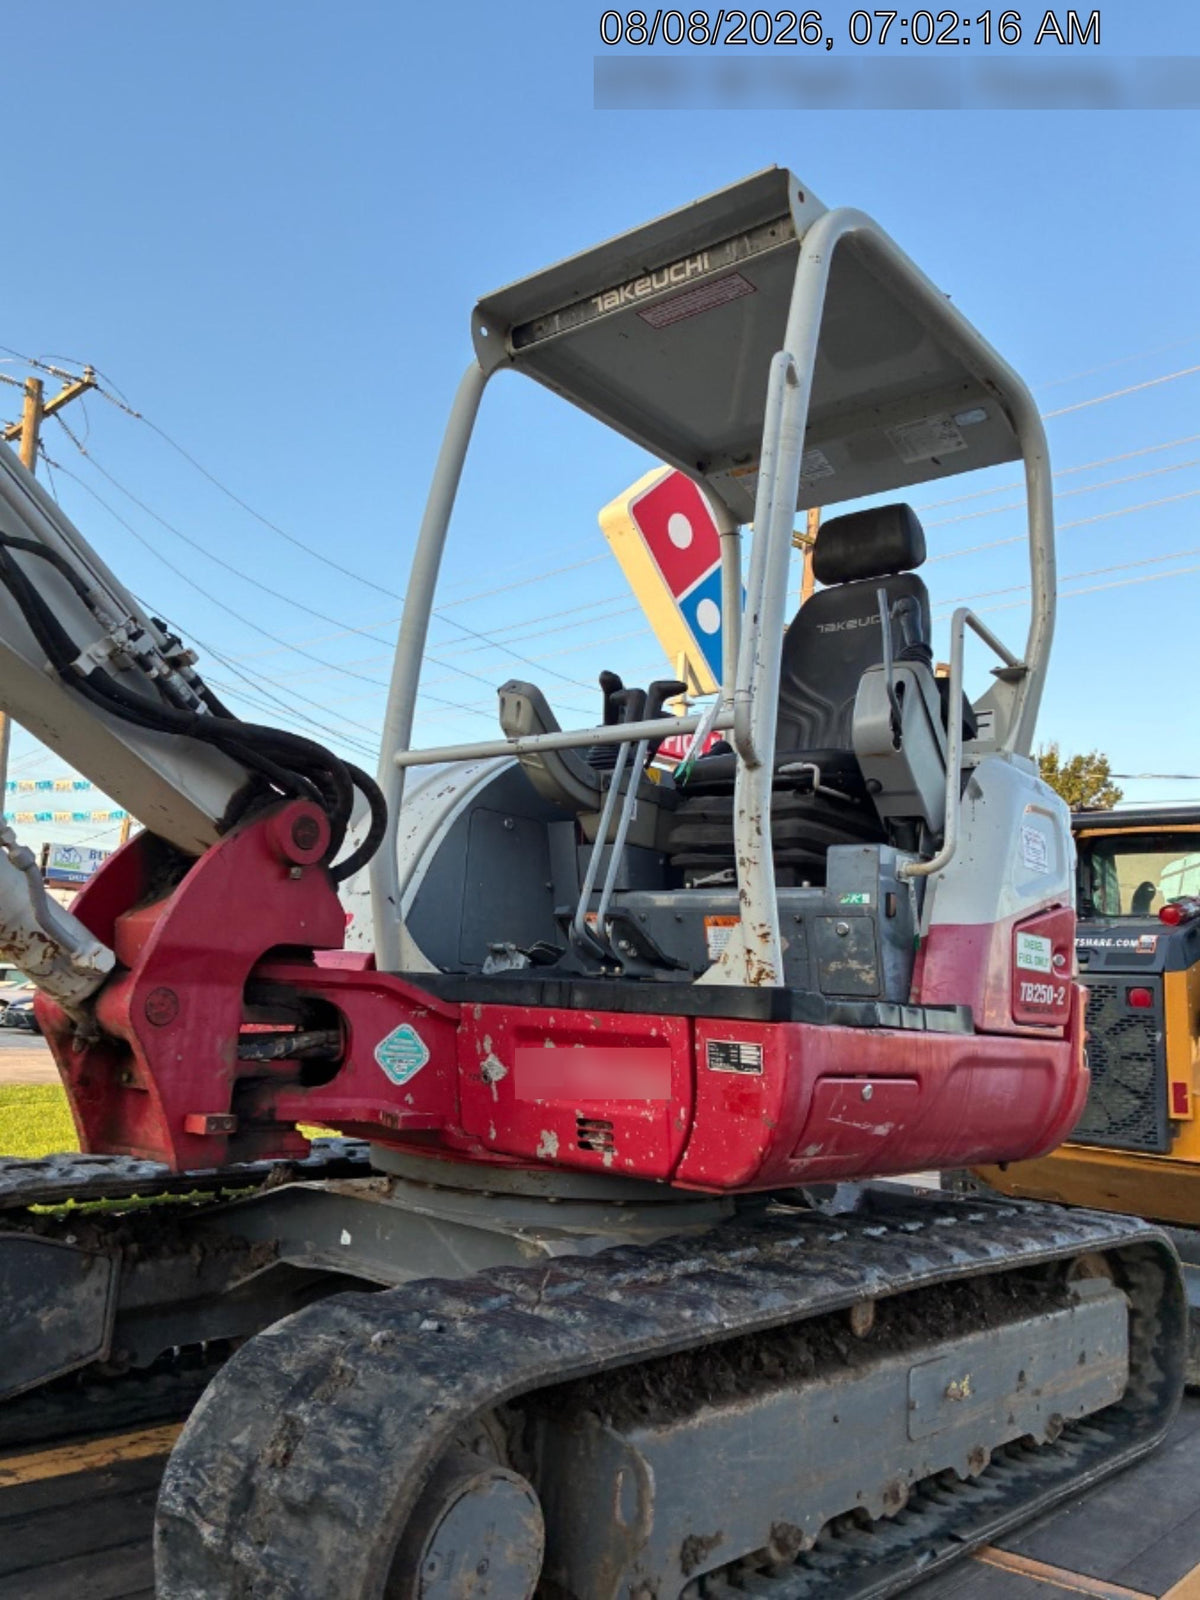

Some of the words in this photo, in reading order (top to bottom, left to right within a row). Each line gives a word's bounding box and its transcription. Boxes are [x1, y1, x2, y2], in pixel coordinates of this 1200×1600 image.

[815, 614, 881, 634] TAKEUC
[1073, 937, 1138, 948] TSHARE.COM
[1019, 982, 1066, 1006] TB250-2
